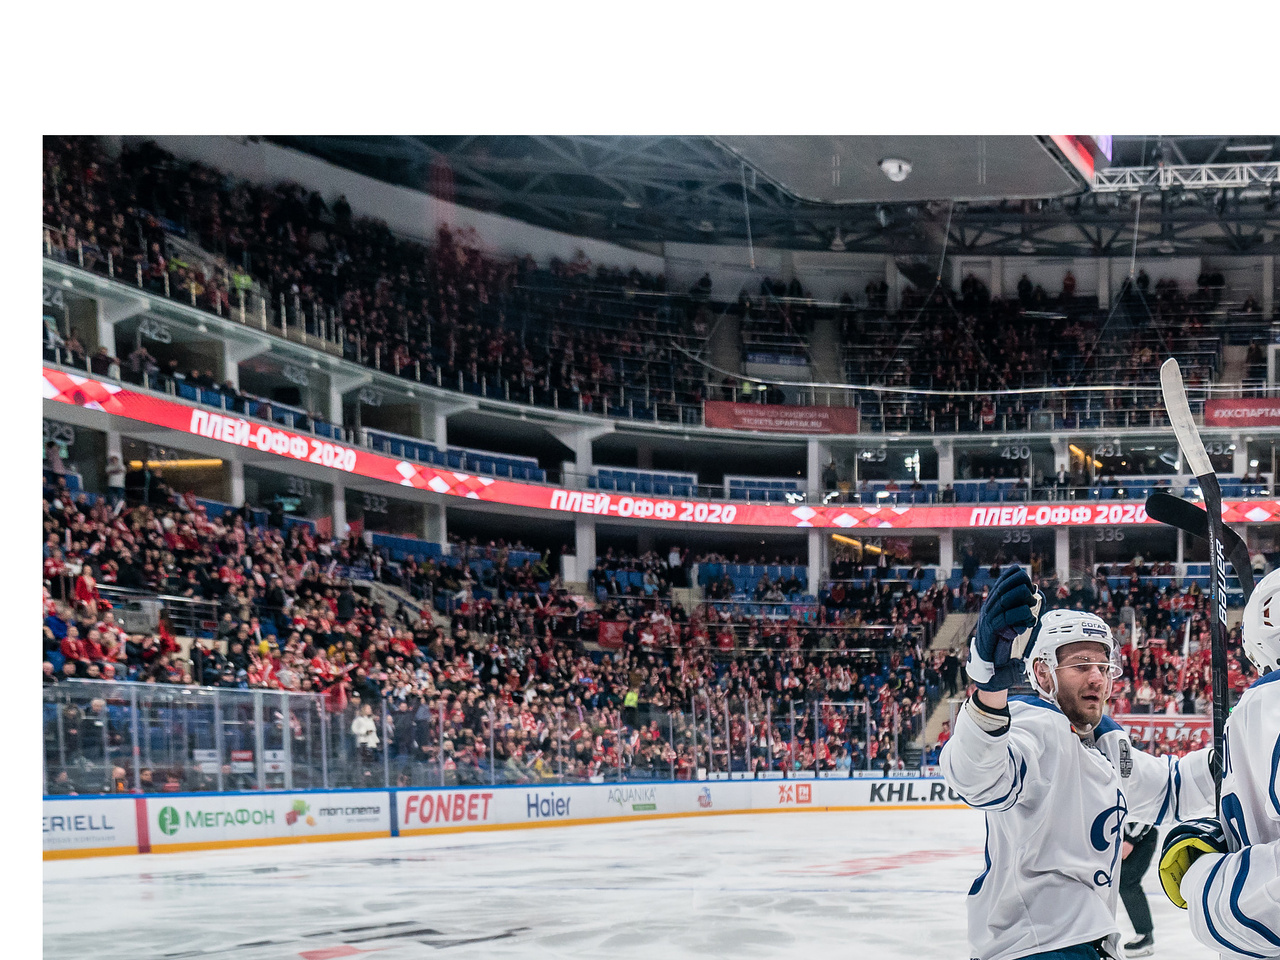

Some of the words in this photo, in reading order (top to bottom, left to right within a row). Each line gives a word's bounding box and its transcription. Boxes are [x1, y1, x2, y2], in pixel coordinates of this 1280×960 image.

[190, 409, 308, 459] ПЛЕЙ-ОФФ
[309, 440, 357, 472] 2020
[1205, 441, 1232, 455] 432
[1001, 446, 1030, 460] 430
[1095, 444, 1123, 457] 431
[550, 489, 676, 519] ПЛЕЙ-ОФФ
[679, 502, 737, 523] 2020
[969, 505, 1092, 526] ПЛЕЙ-ОФФ
[1095, 504, 1149, 523] 2020
[1002, 529, 1030, 543] 335
[1095, 528, 1124, 542] 336
[1216, 538, 1228, 627] BAUER
[1081, 621, 1107, 630] СОГАЗ
[404, 793, 493, 824] FONBET
[526, 790, 571, 818] Haier
